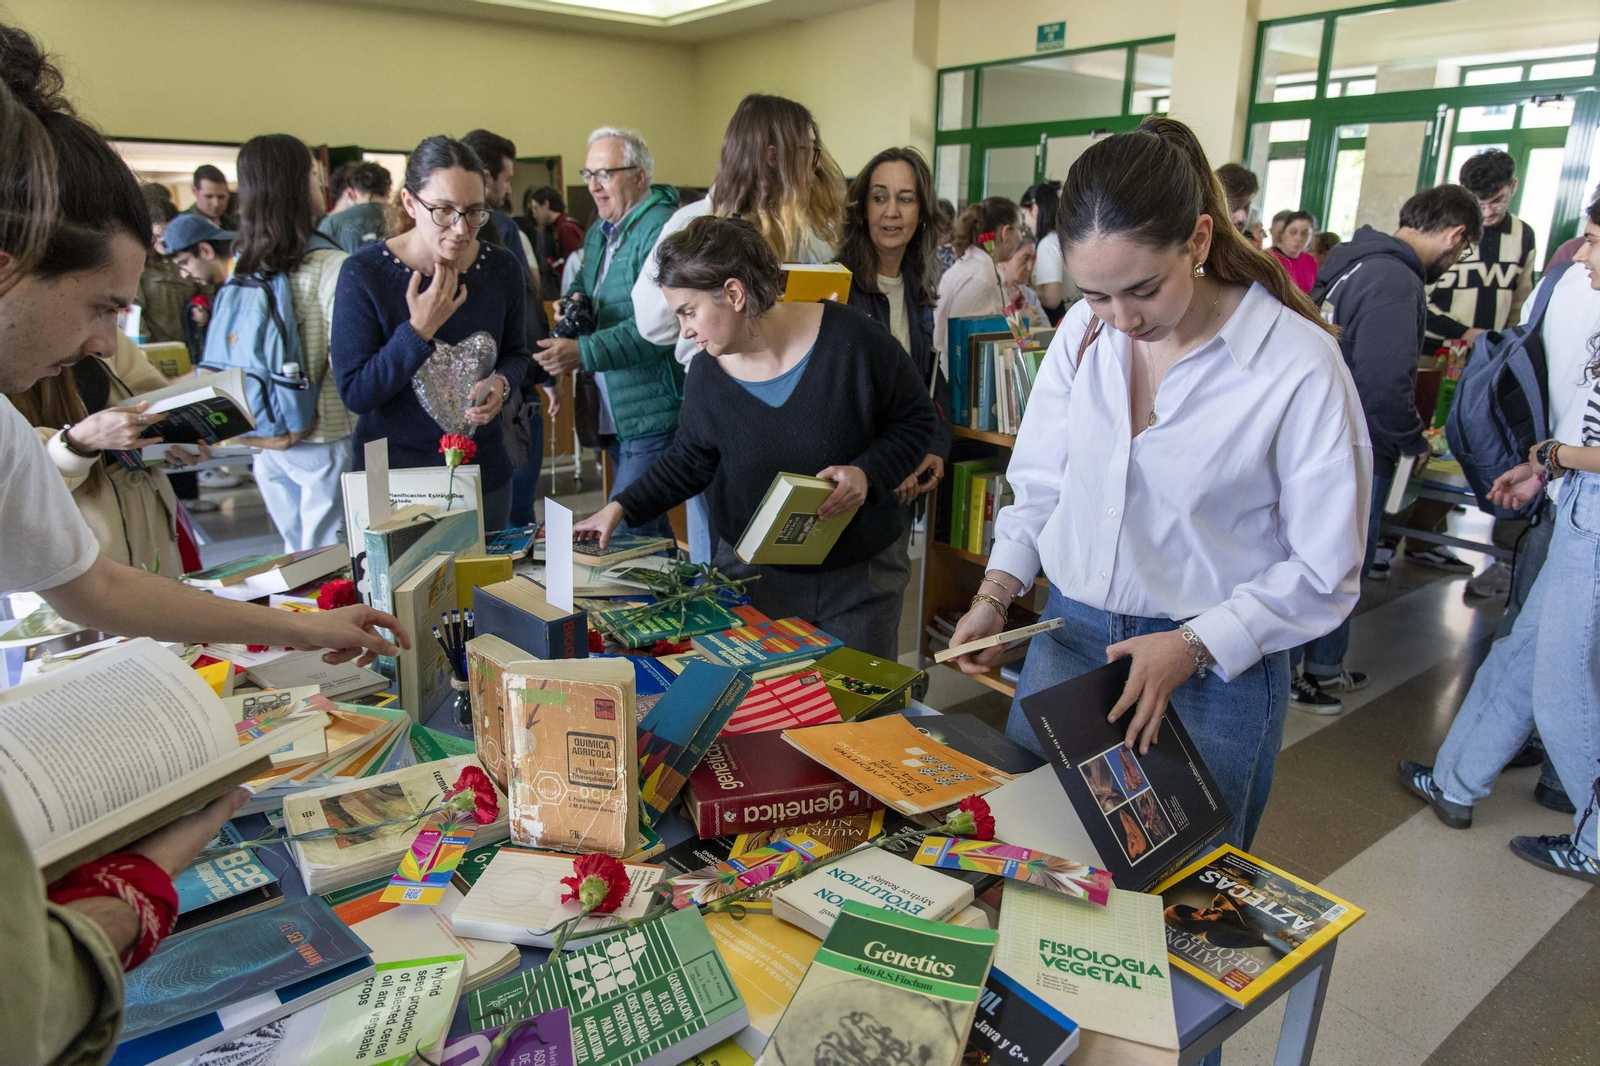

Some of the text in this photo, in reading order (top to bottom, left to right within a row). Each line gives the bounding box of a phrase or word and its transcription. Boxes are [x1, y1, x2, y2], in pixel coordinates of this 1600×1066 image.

[572, 747, 612, 759] AGRICOLA
[574, 738, 610, 750] QUIMICA
[1040, 715, 1072, 770] Atlas en Color
[884, 769, 925, 794] sobre
[214, 850, 270, 892] B29
[867, 875, 900, 891] Reality?
[813, 888, 847, 908] ION
[826, 867, 926, 915] EVOLUTION
[910, 893, 935, 907] Myth
[1199, 870, 1316, 930] AZTECAS
[864, 940, 956, 978] Genetics
[1039, 938, 1165, 979] FISIOLOGIA
[1165, 925, 1226, 974] NATION
[428, 966, 448, 997] Hybrid
[854, 963, 876, 976] John
[895, 974, 933, 991] Fincham
[1039, 953, 1142, 990] VEGETAL
[357, 977, 375, 1006] crops
[396, 969, 428, 1045] seed production
[641, 989, 665, 1031] MERCADOS Y
[657, 991, 676, 1015] DE LOS
[667, 972, 695, 1022] GLOBALIZACION
[979, 986, 1003, 1016] ML
[356, 975, 394, 1060] oil and vegetable
[374, 972, 412, 1058] of selected cereal
[600, 1016, 618, 1046] PARA LA
[612, 1002, 636, 1047] PERSPECTIVAS
[625, 992, 651, 1044] CRISIS AGRARIA:
[533, 1049, 546, 1066] ASO
[548, 1045, 558, 1066] Boletí
[572, 1026, 590, 1065] ANDALUZA
[583, 1015, 606, 1062] AGRICULTURA
[974, 1019, 1030, 1064] Java y C++
